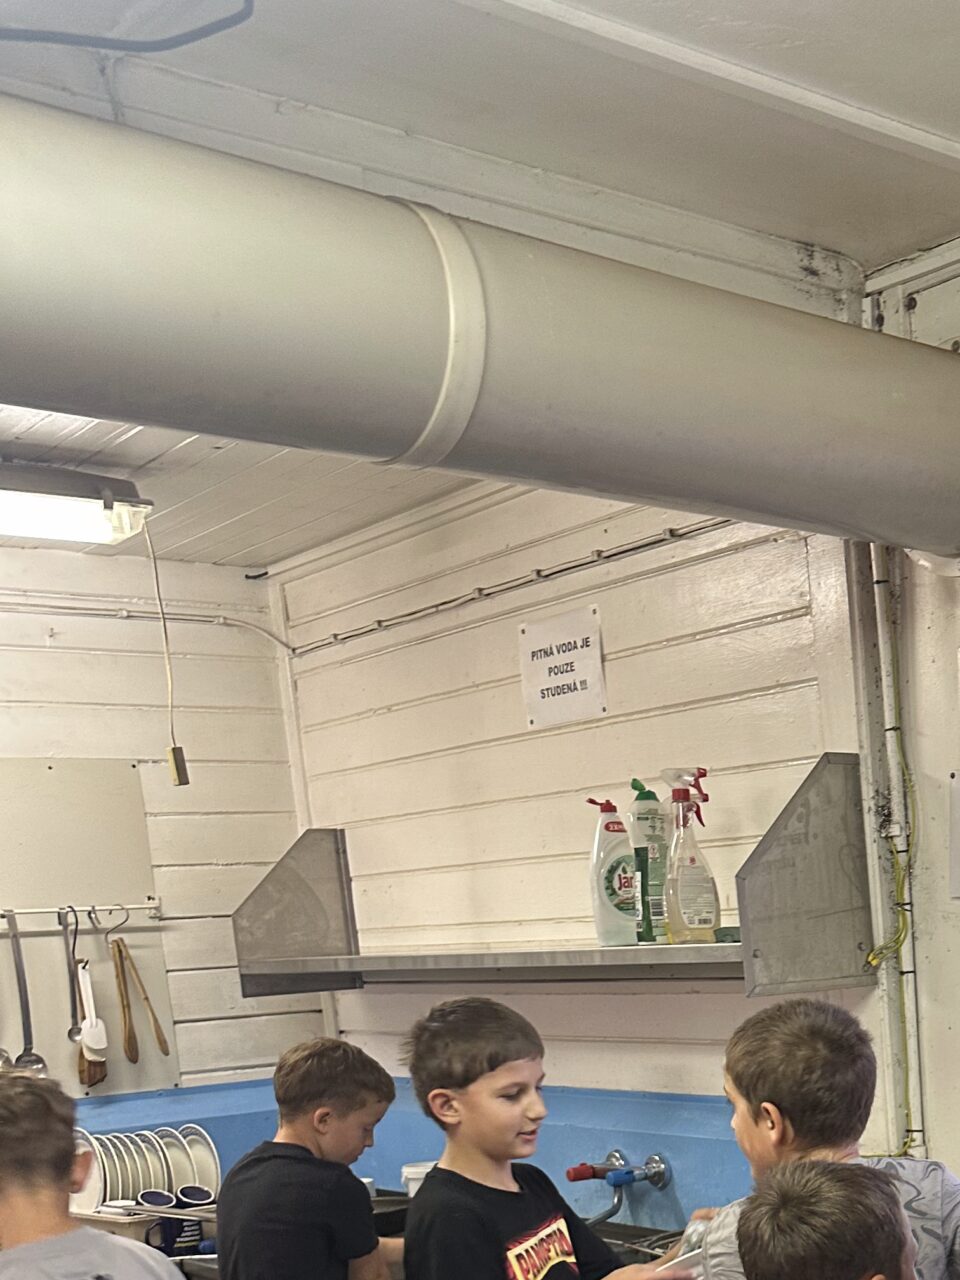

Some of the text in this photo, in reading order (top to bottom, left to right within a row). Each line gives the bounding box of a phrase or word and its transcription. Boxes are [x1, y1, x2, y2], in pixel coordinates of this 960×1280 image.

[531, 637, 591, 661] PITNÁ VODA JE
[548, 661, 575, 677] POUZE
[540, 680, 579, 699] STUDENÁ
[617, 874, 634, 891] Jar
